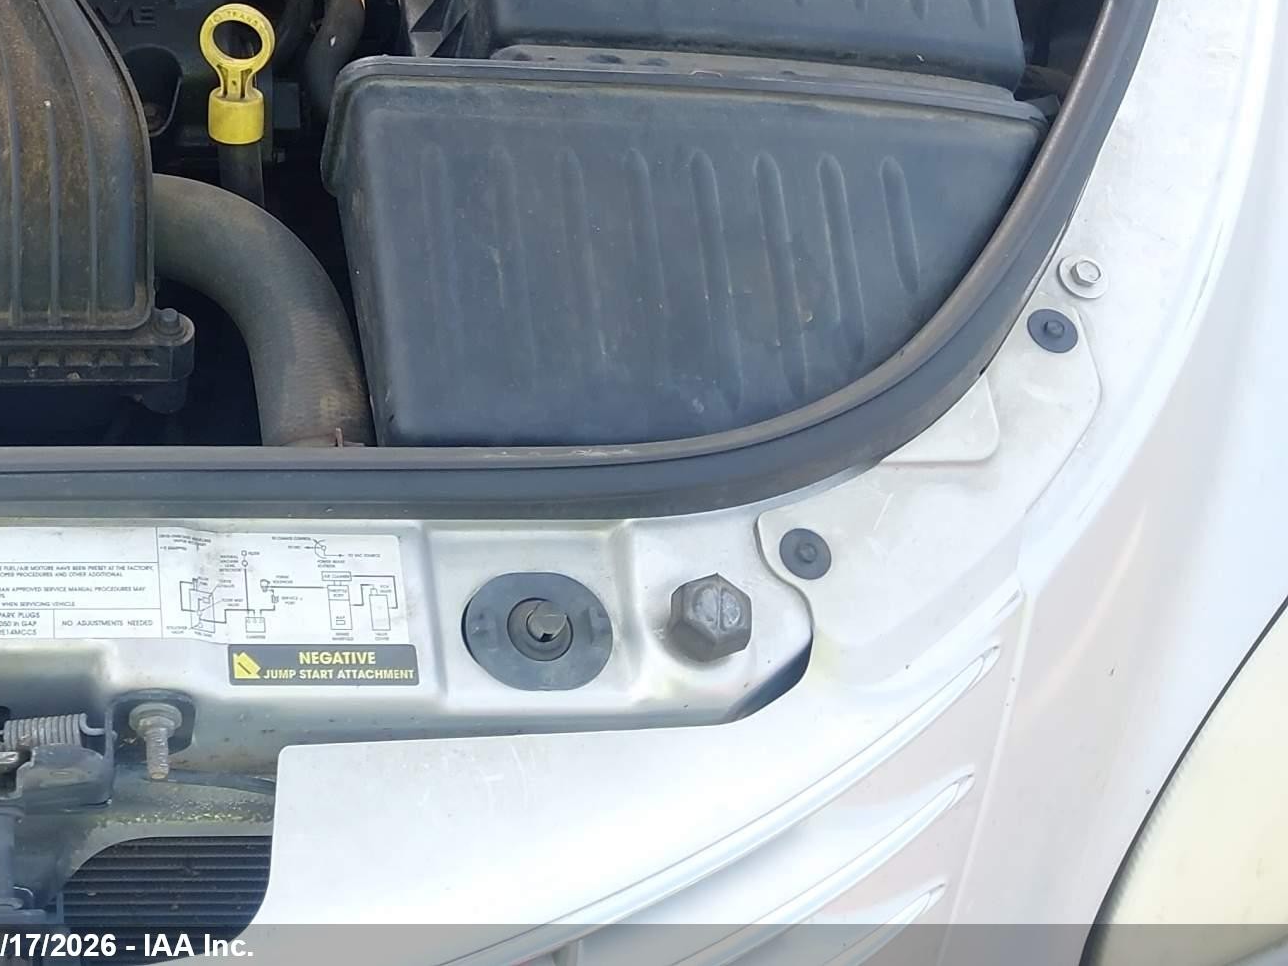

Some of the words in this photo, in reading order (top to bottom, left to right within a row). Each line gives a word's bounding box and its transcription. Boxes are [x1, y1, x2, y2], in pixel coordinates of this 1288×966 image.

[298, 651, 377, 665] NEGATIVE
[263, 669, 296, 679] JUMP
[299, 669, 334, 679] START
[337, 669, 414, 679] ATTACHMENT
